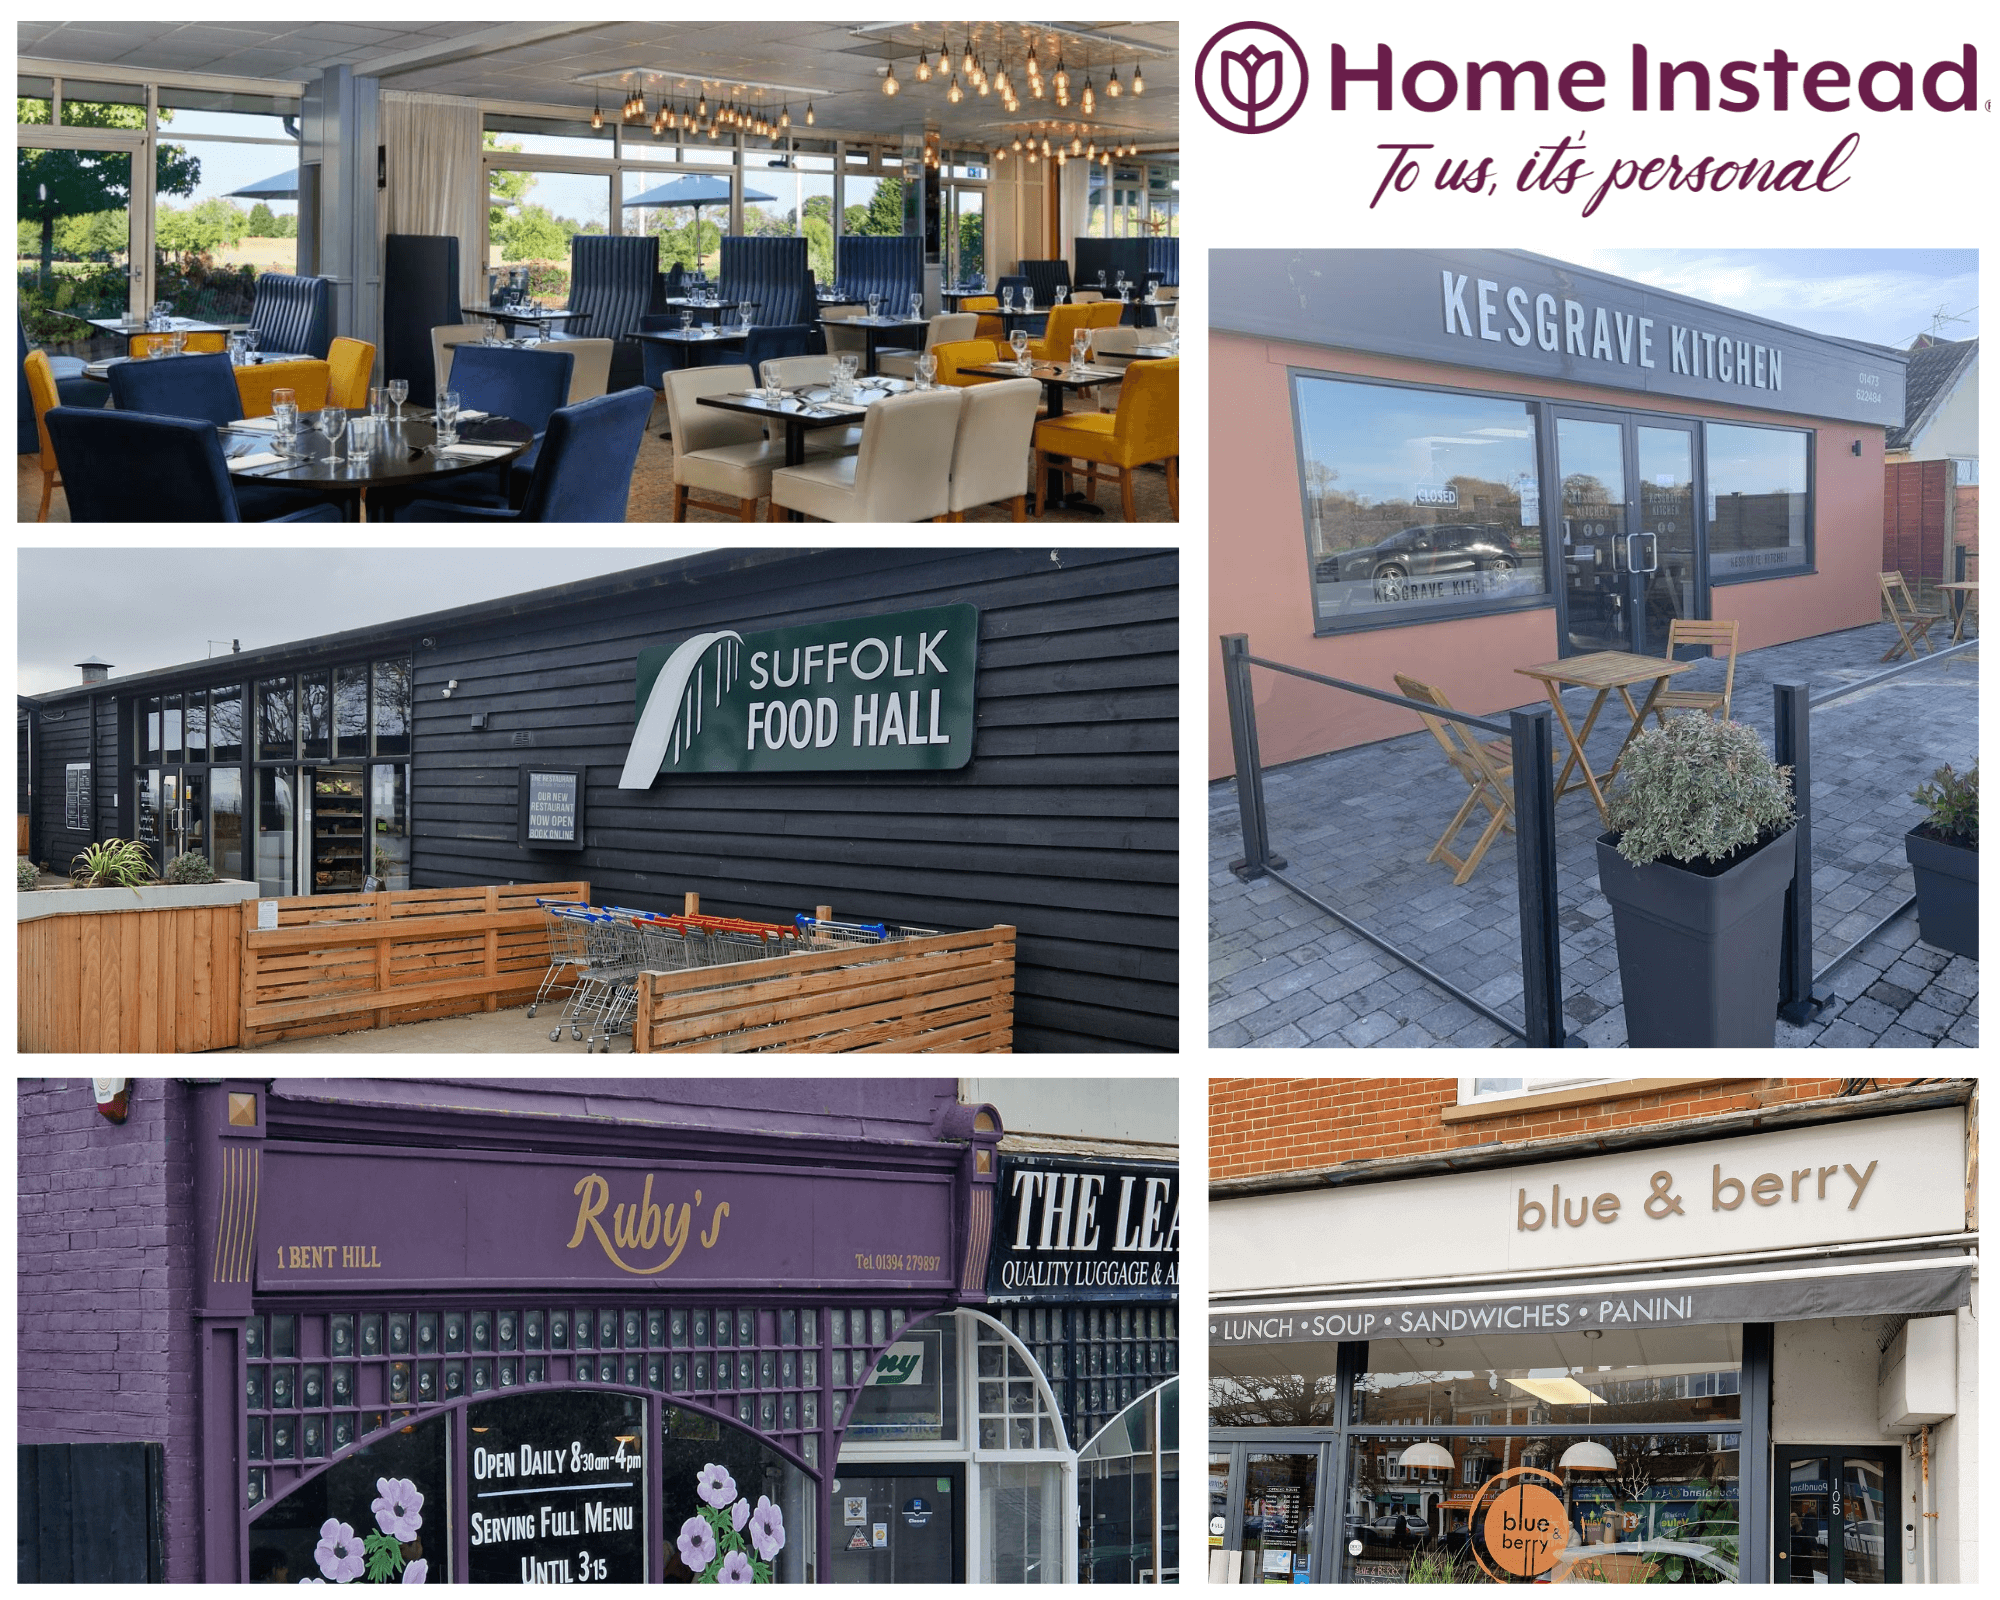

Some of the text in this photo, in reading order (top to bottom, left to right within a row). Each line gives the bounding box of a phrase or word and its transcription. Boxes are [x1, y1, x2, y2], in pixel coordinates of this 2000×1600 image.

[1442, 270, 1782, 391] KESGRAVE KITCHEN
[1859, 372, 1880, 387] 01473
[1856, 388, 1882, 404] 622484
[1417, 489, 1456, 504] CLOSED
[1764, 552, 1788, 565] KITCHEN
[1374, 582, 1444, 603] KESGRAVE
[750, 629, 949, 690] SUFFOLK
[747, 688, 950, 750] FOOD HALL
[531, 774, 576, 784] THE RESTAURANT
[531, 802, 574, 812] RESTAURANT
[537, 791, 568, 802] OUR NEW
[530, 815, 573, 827] NOW OPEN
[529, 829, 574, 840] BOOK ONLINE
[1517, 1159, 1879, 1231] blue & berry
[1011, 1170, 1106, 1250] THE
[566, 1173, 730, 1274] Ruby's
[277, 1245, 382, 1269] 1 BENT HILL
[855, 1253, 941, 1271] Tel. 01394 279897
[1002, 1260, 1074, 1288] QUALITY
[1074, 1260, 1149, 1286] LUGGAGE
[1150, 1261, 1162, 1286] &
[1224, 1295, 1692, 1340] LUNCH SOUP SANDWICHES PANINI
[474, 1447, 515, 1480] OPEN
[520, 1443, 567, 1477] DAILY
[1832, 1477, 1841, 1516] 105
[471, 1501, 633, 1546] SERVING FULL MENU
[521, 1556, 574, 1584] UNTIL
